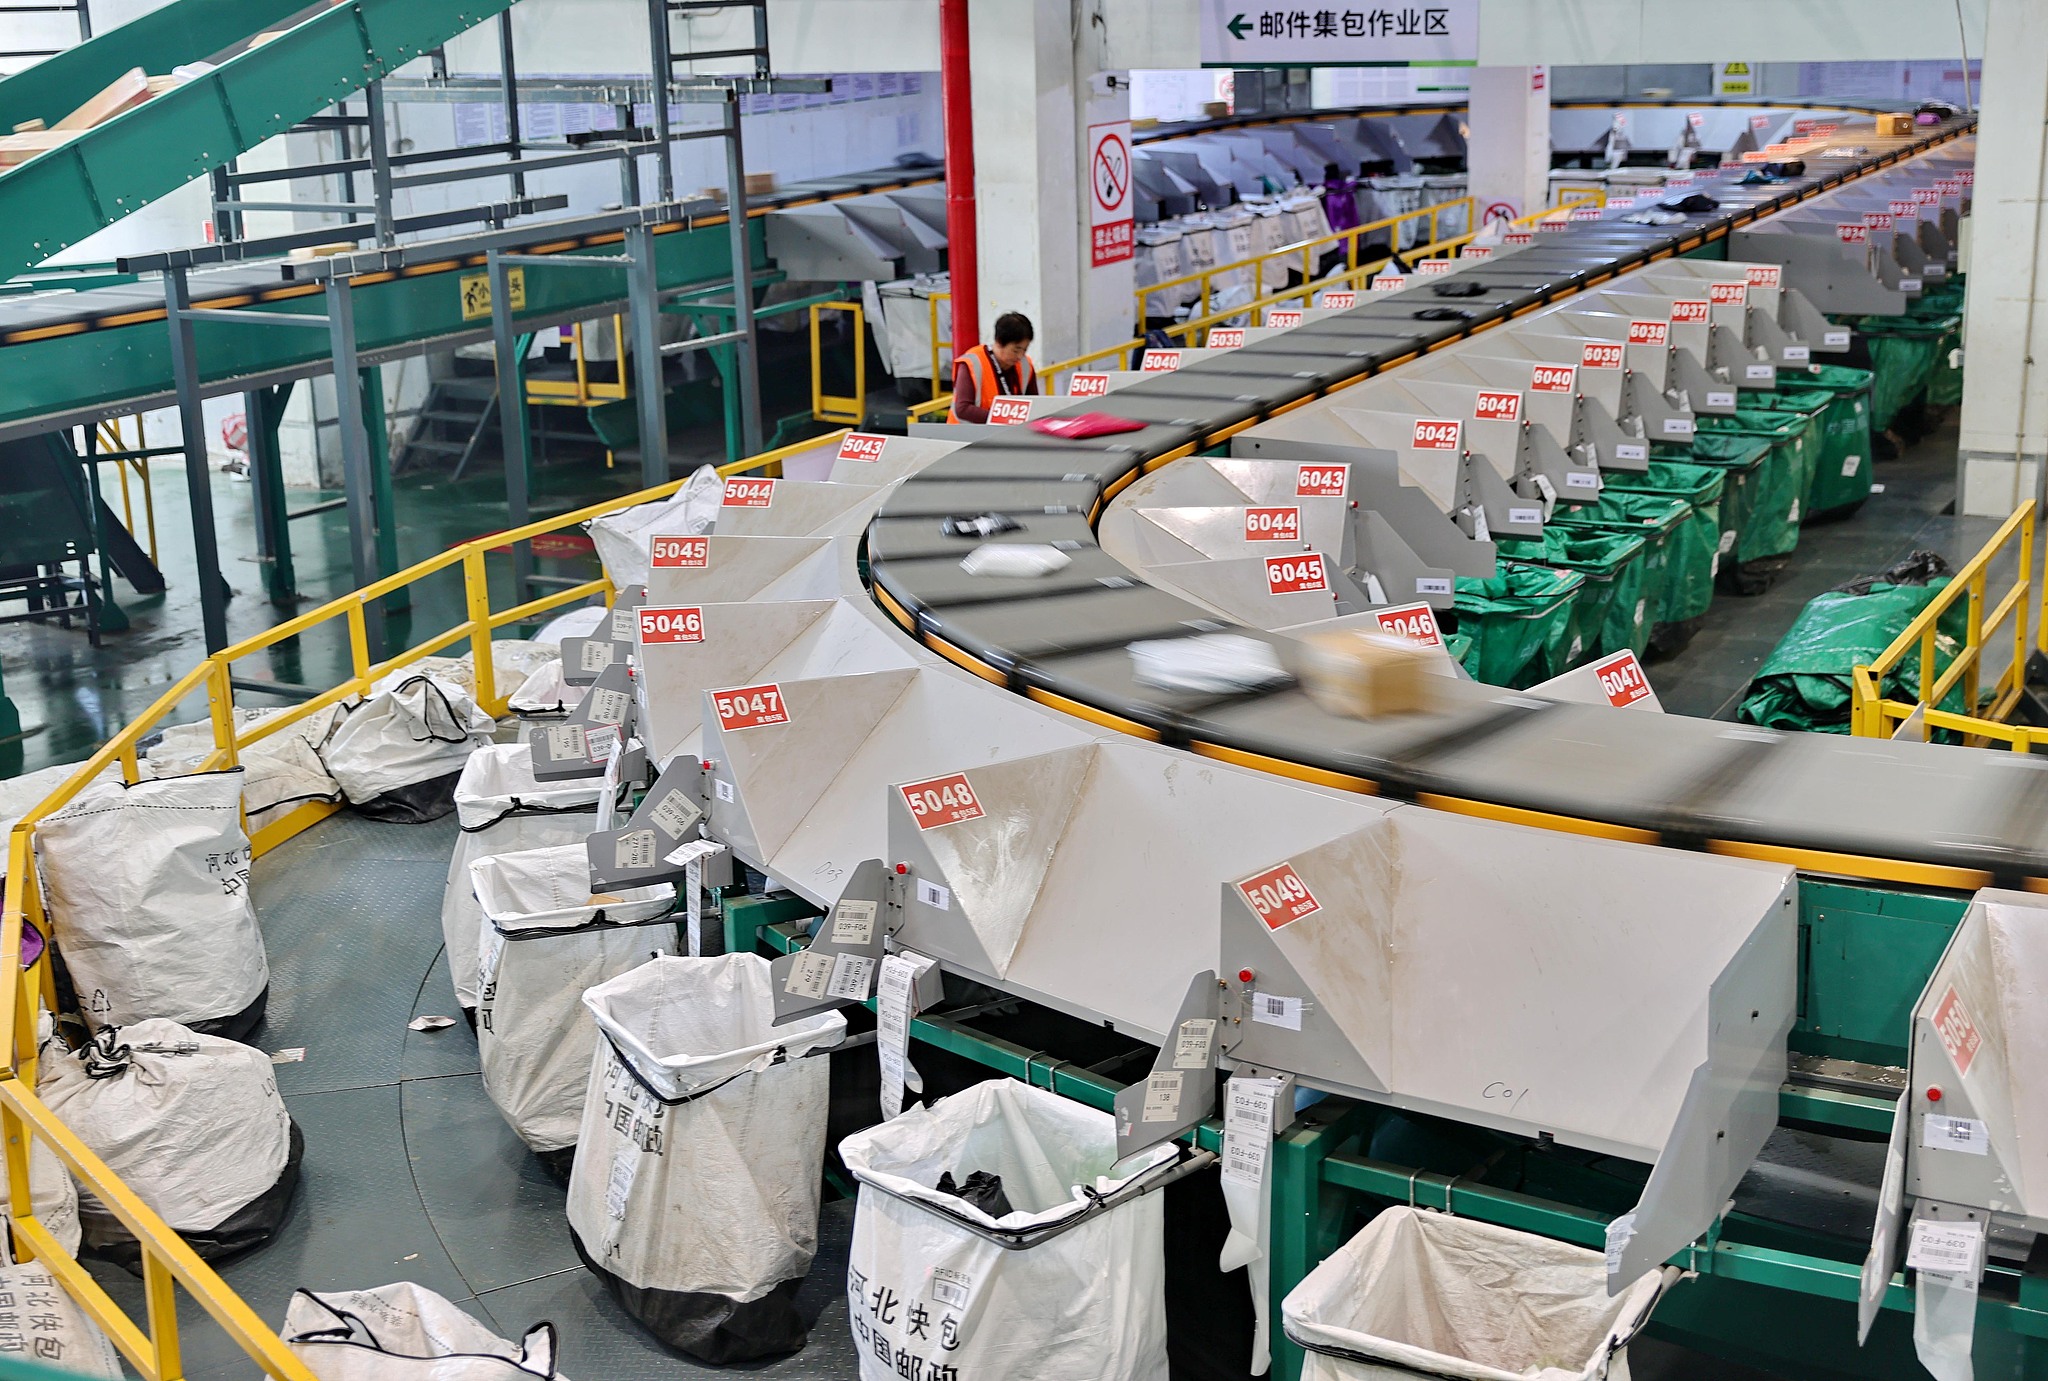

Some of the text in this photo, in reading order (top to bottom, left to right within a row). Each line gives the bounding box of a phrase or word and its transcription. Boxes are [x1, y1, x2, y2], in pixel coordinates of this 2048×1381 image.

[1260, 9, 1449, 38] 邮件集包作业区
[1420, 264, 1449, 275] 5035
[1746, 269, 1778, 282] 6035
[1374, 279, 1404, 291] 5036
[1711, 286, 1744, 300] 6036
[1323, 296, 1354, 309] 5037
[1672, 304, 1707, 317] 6037
[1268, 315, 1299, 328] 5038
[1630, 324, 1665, 338] 6038
[1210, 334, 1242, 347] 5039
[1145, 355, 1178, 369] 5040
[1583, 347, 1620, 362] 6039
[1072, 379, 1105, 393] 5041
[1533, 370, 1571, 386] 6040
[992, 404, 1027, 418] 5042
[1478, 396, 1517, 412] 6041
[1416, 426, 1456, 442] 6042
[844, 438, 882, 454] 5043
[1300, 471, 1343, 488] 6043
[725, 484, 771, 499] 5044
[1247, 513, 1297, 531] 6044
[654, 542, 706, 558] 5045
[1268, 561, 1322, 583] 6045
[642, 614, 699, 633] 5046
[1382, 613, 1433, 639] 6046
[1601, 663, 1642, 697] 6047
[717, 691, 778, 718] 5047
[908, 783, 974, 815] 5048
[1249, 874, 1306, 915] 5049
[1939, 999, 1971, 1056] 5050
[1235, 1096, 1268, 1110] 039-F03
[1230, 1146, 1260, 1161] 039-F03
[1921, 1235, 1967, 1249] 039-F02
[850, 1264, 960, 1351] 河北快包
[20, 1274, 66, 1360] 河北快包
